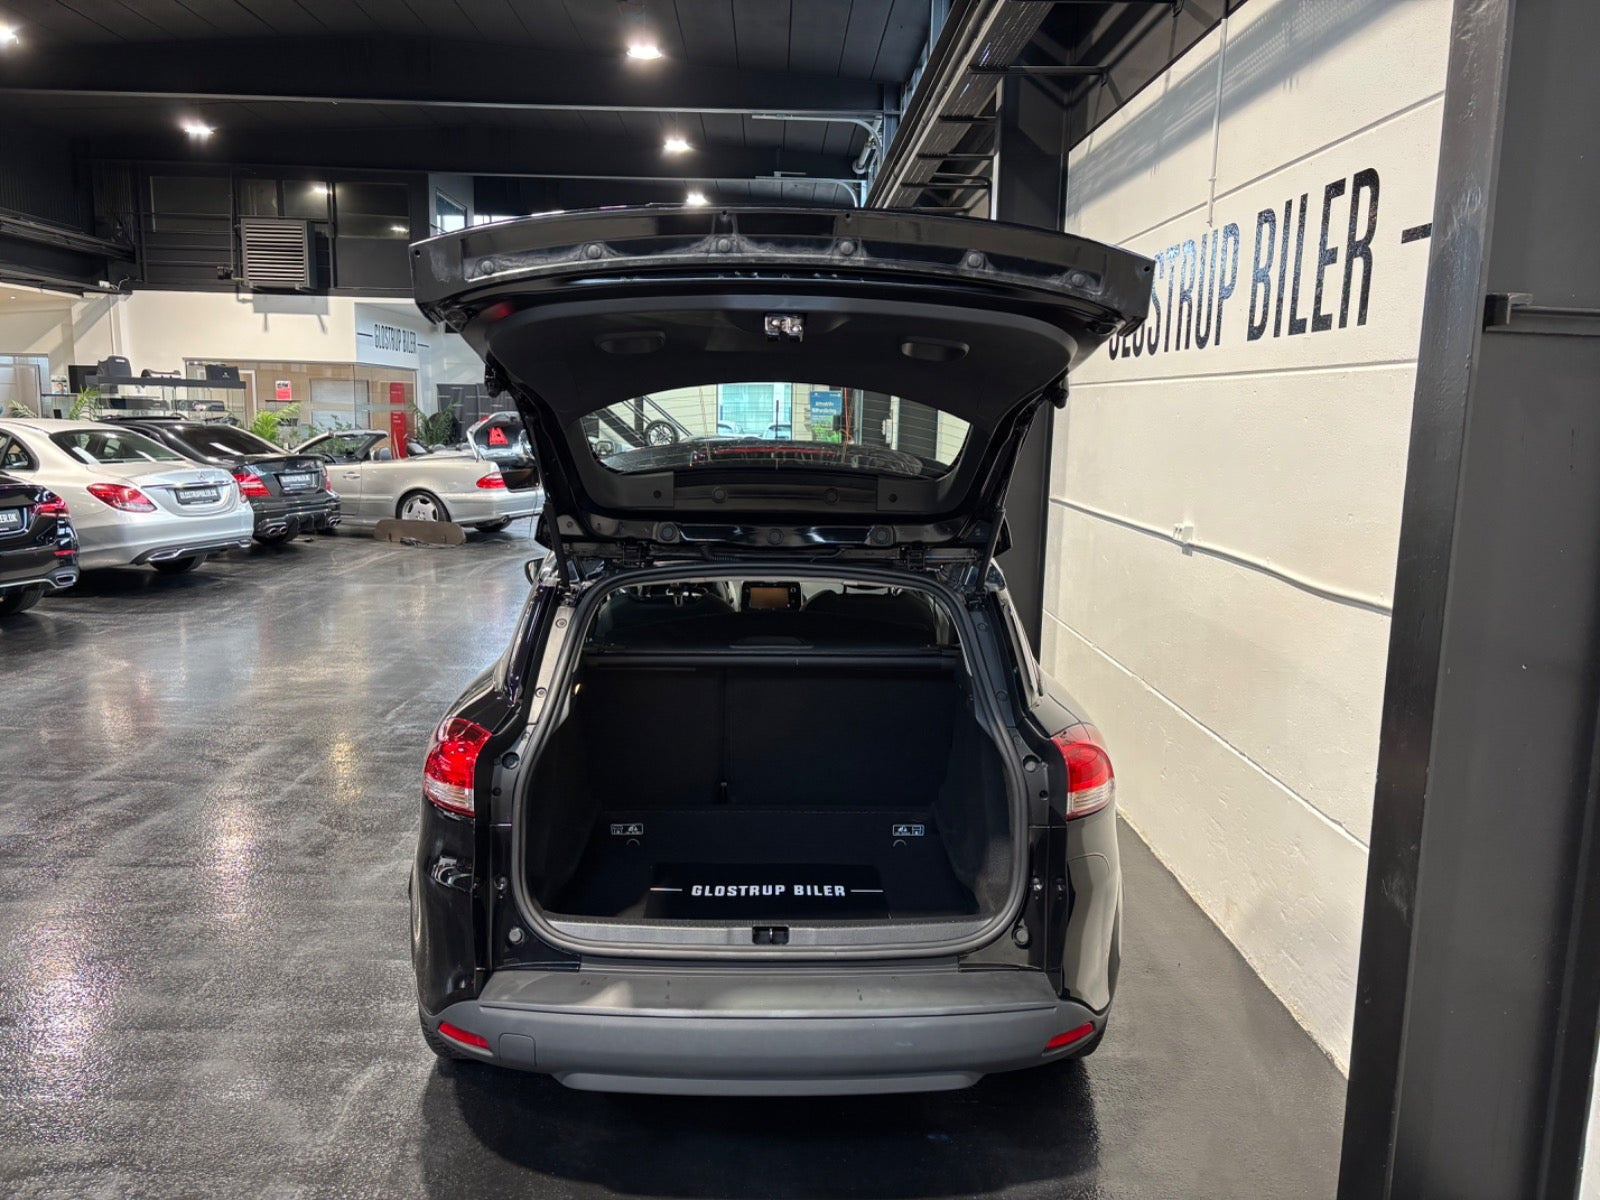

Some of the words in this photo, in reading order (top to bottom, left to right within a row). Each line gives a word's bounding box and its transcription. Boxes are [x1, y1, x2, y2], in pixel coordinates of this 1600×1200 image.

[1108, 222, 1240, 361] STRUP
[1247, 167, 1380, 342] BILER
[374, 324, 402, 352] GLOSTRUP
[691, 884, 786, 897] GLOSTRUP
[793, 884, 846, 897] BILER
